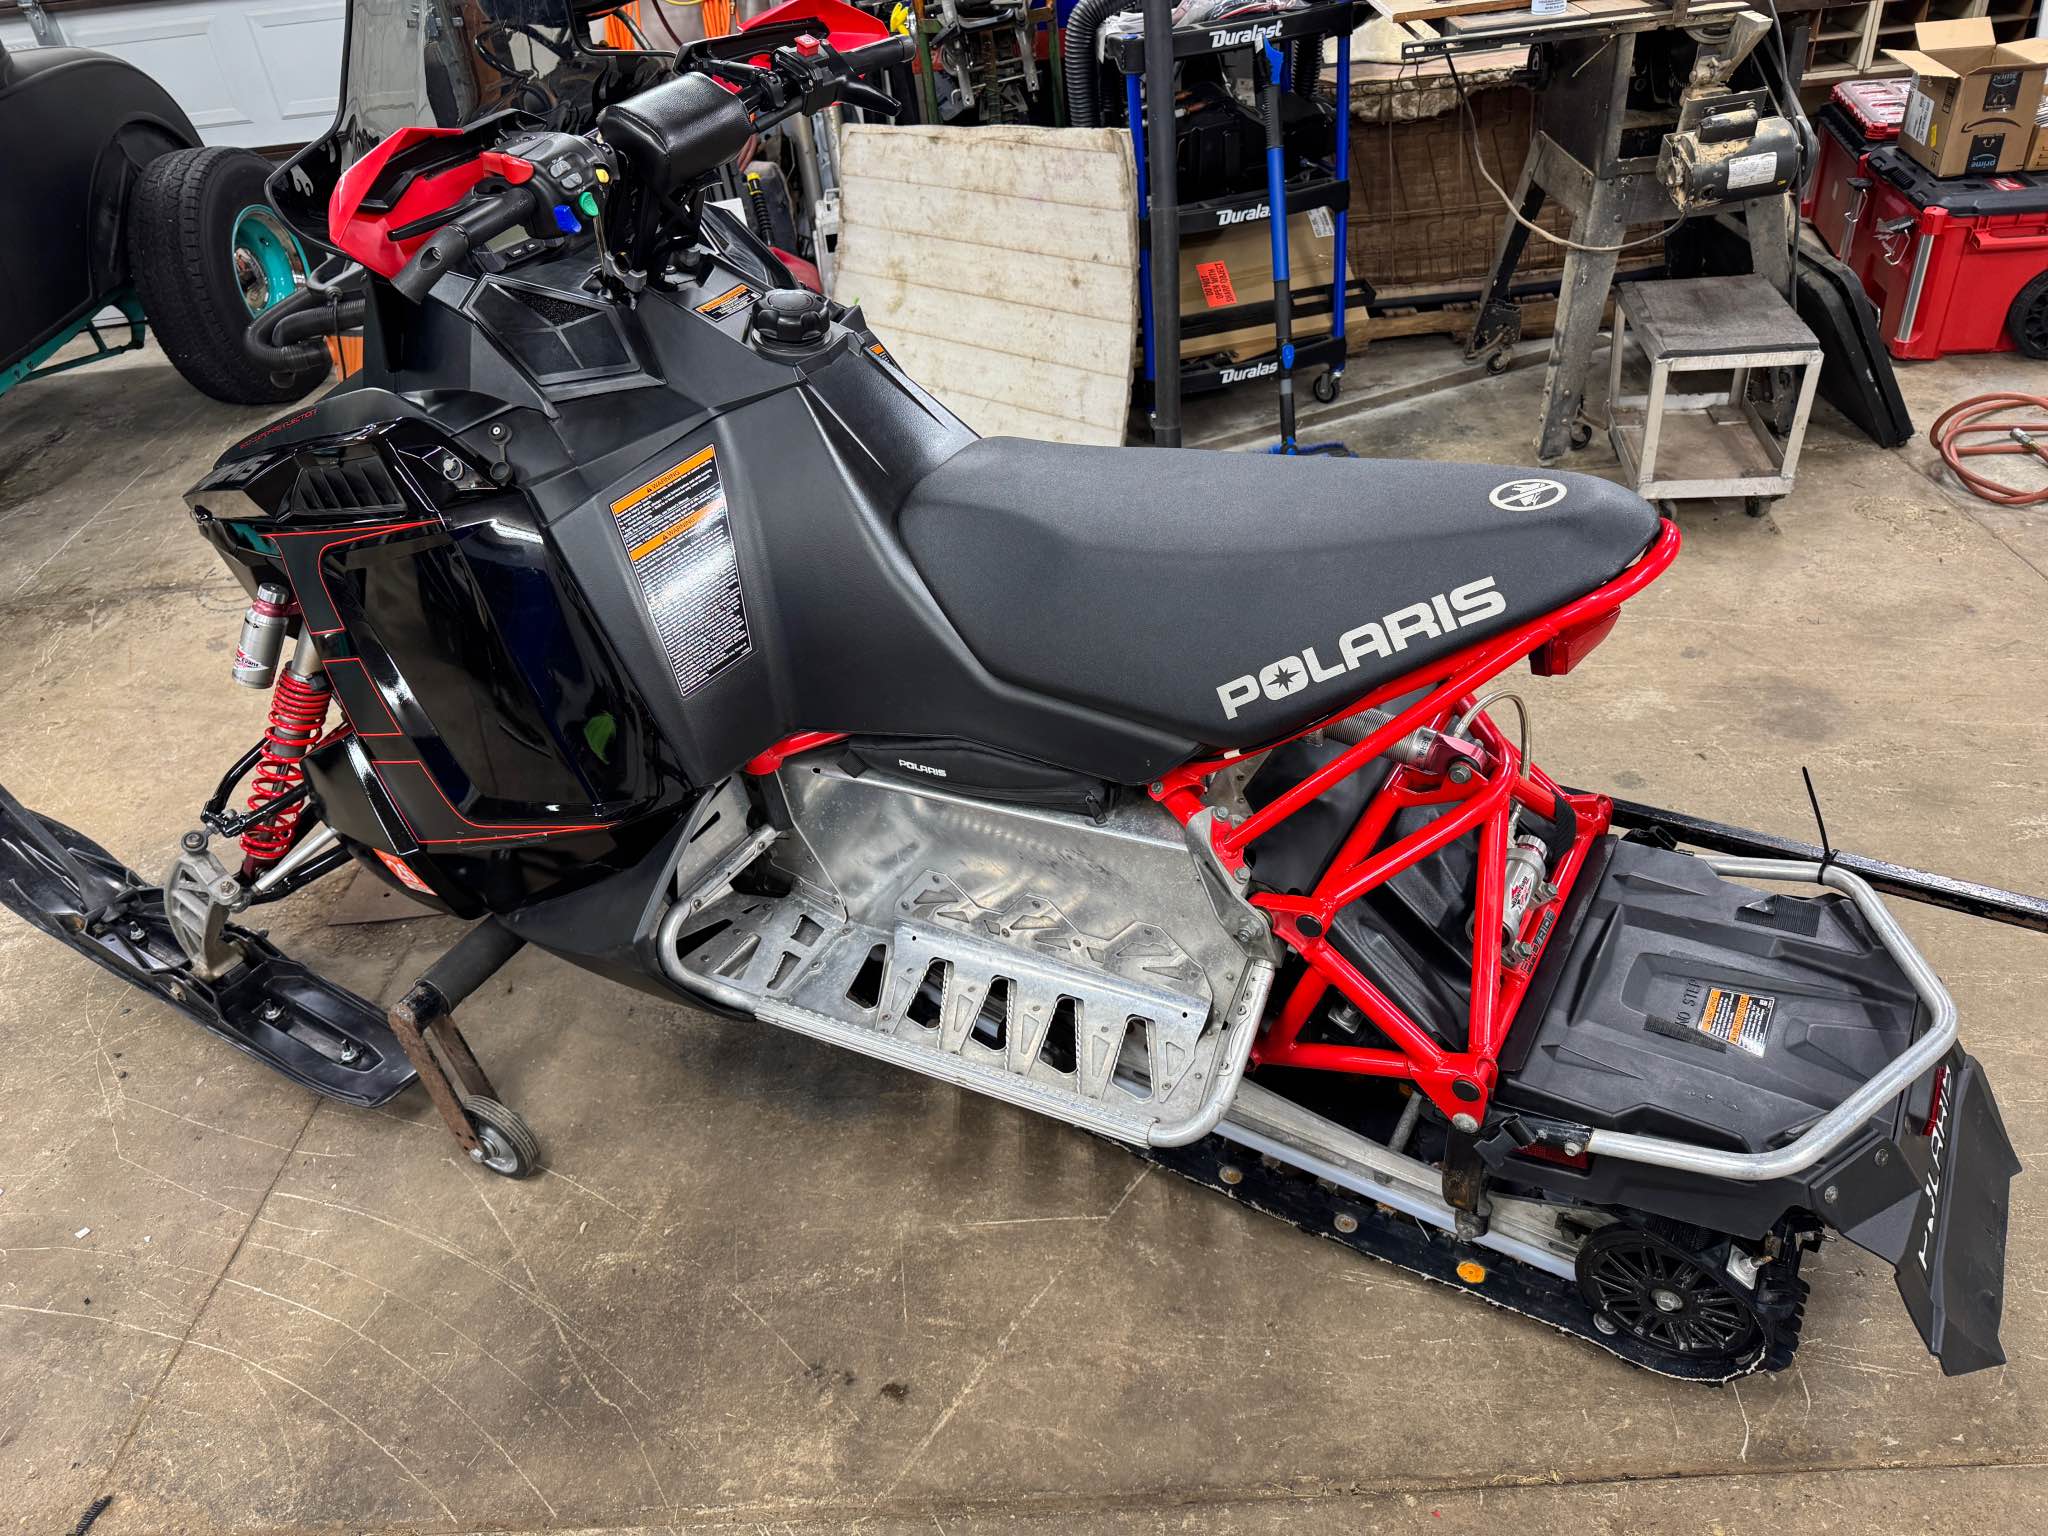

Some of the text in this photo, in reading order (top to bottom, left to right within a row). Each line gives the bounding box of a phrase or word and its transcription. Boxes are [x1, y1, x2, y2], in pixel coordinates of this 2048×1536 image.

[1209, 20, 1283, 48] Duralast
[1970, 159, 1996, 168] prime
[1216, 204, 1271, 226] Durala
[1200, 275, 1213, 296] DO NOT
[1207, 269, 1223, 299] OPEN WITH
[1215, 262, 1233, 302] SHARP OBJECT
[1220, 362, 1278, 384] Duralas
[652, 470, 680, 489] WARNING
[667, 517, 695, 536] WARNING
[1216, 576, 1506, 720] POLARIS
[899, 759, 946, 777] POLARIS
[1675, 976, 1701, 1027] NO STEP
